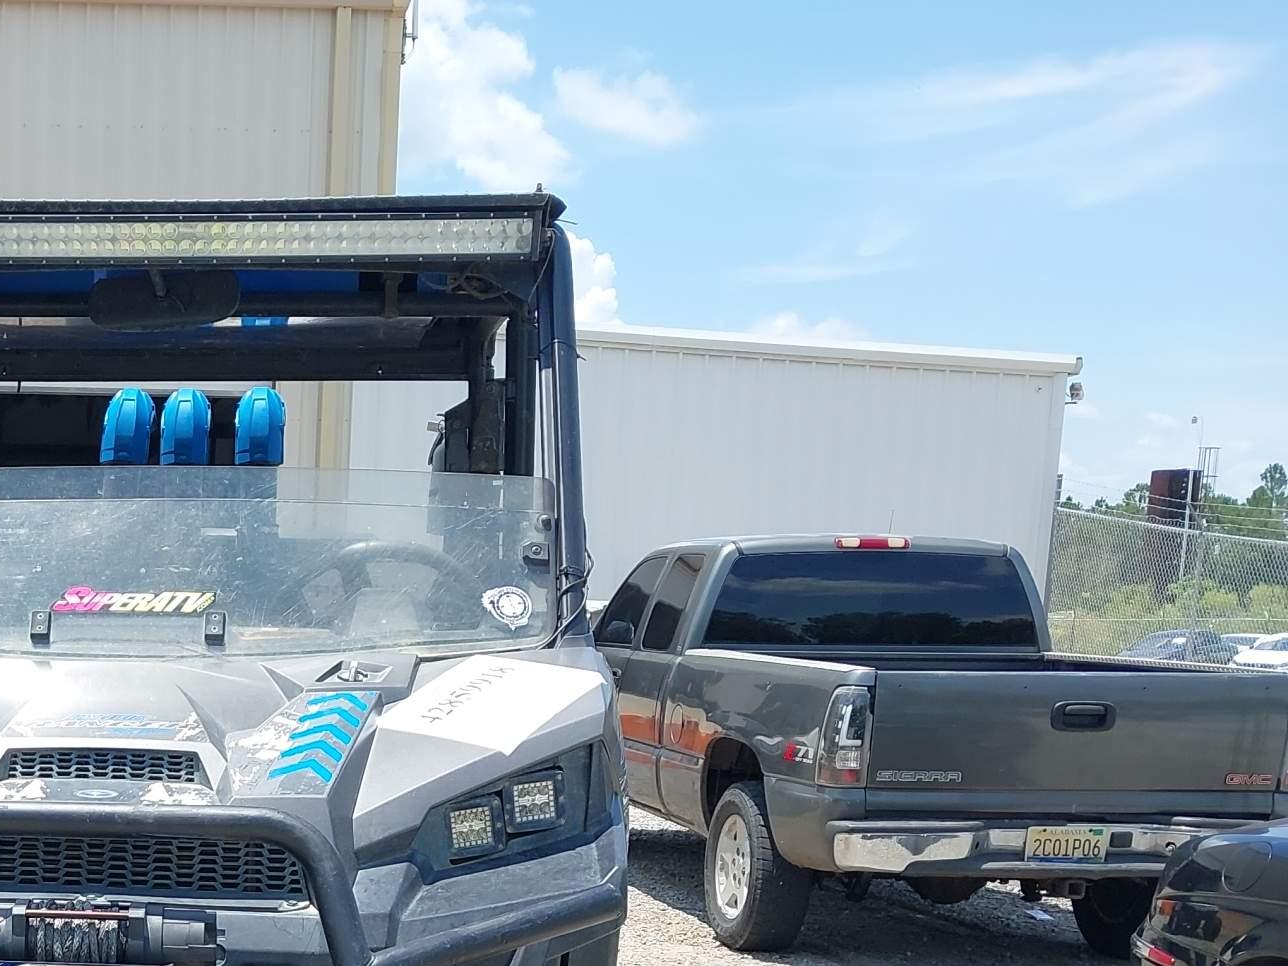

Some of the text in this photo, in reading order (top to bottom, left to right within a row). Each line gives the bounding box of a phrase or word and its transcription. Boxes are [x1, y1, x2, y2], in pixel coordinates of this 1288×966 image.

[875, 770, 962, 783] SIERRA
[1225, 773, 1273, 785] GMC
[1032, 838, 1101, 857] 2C01P06
